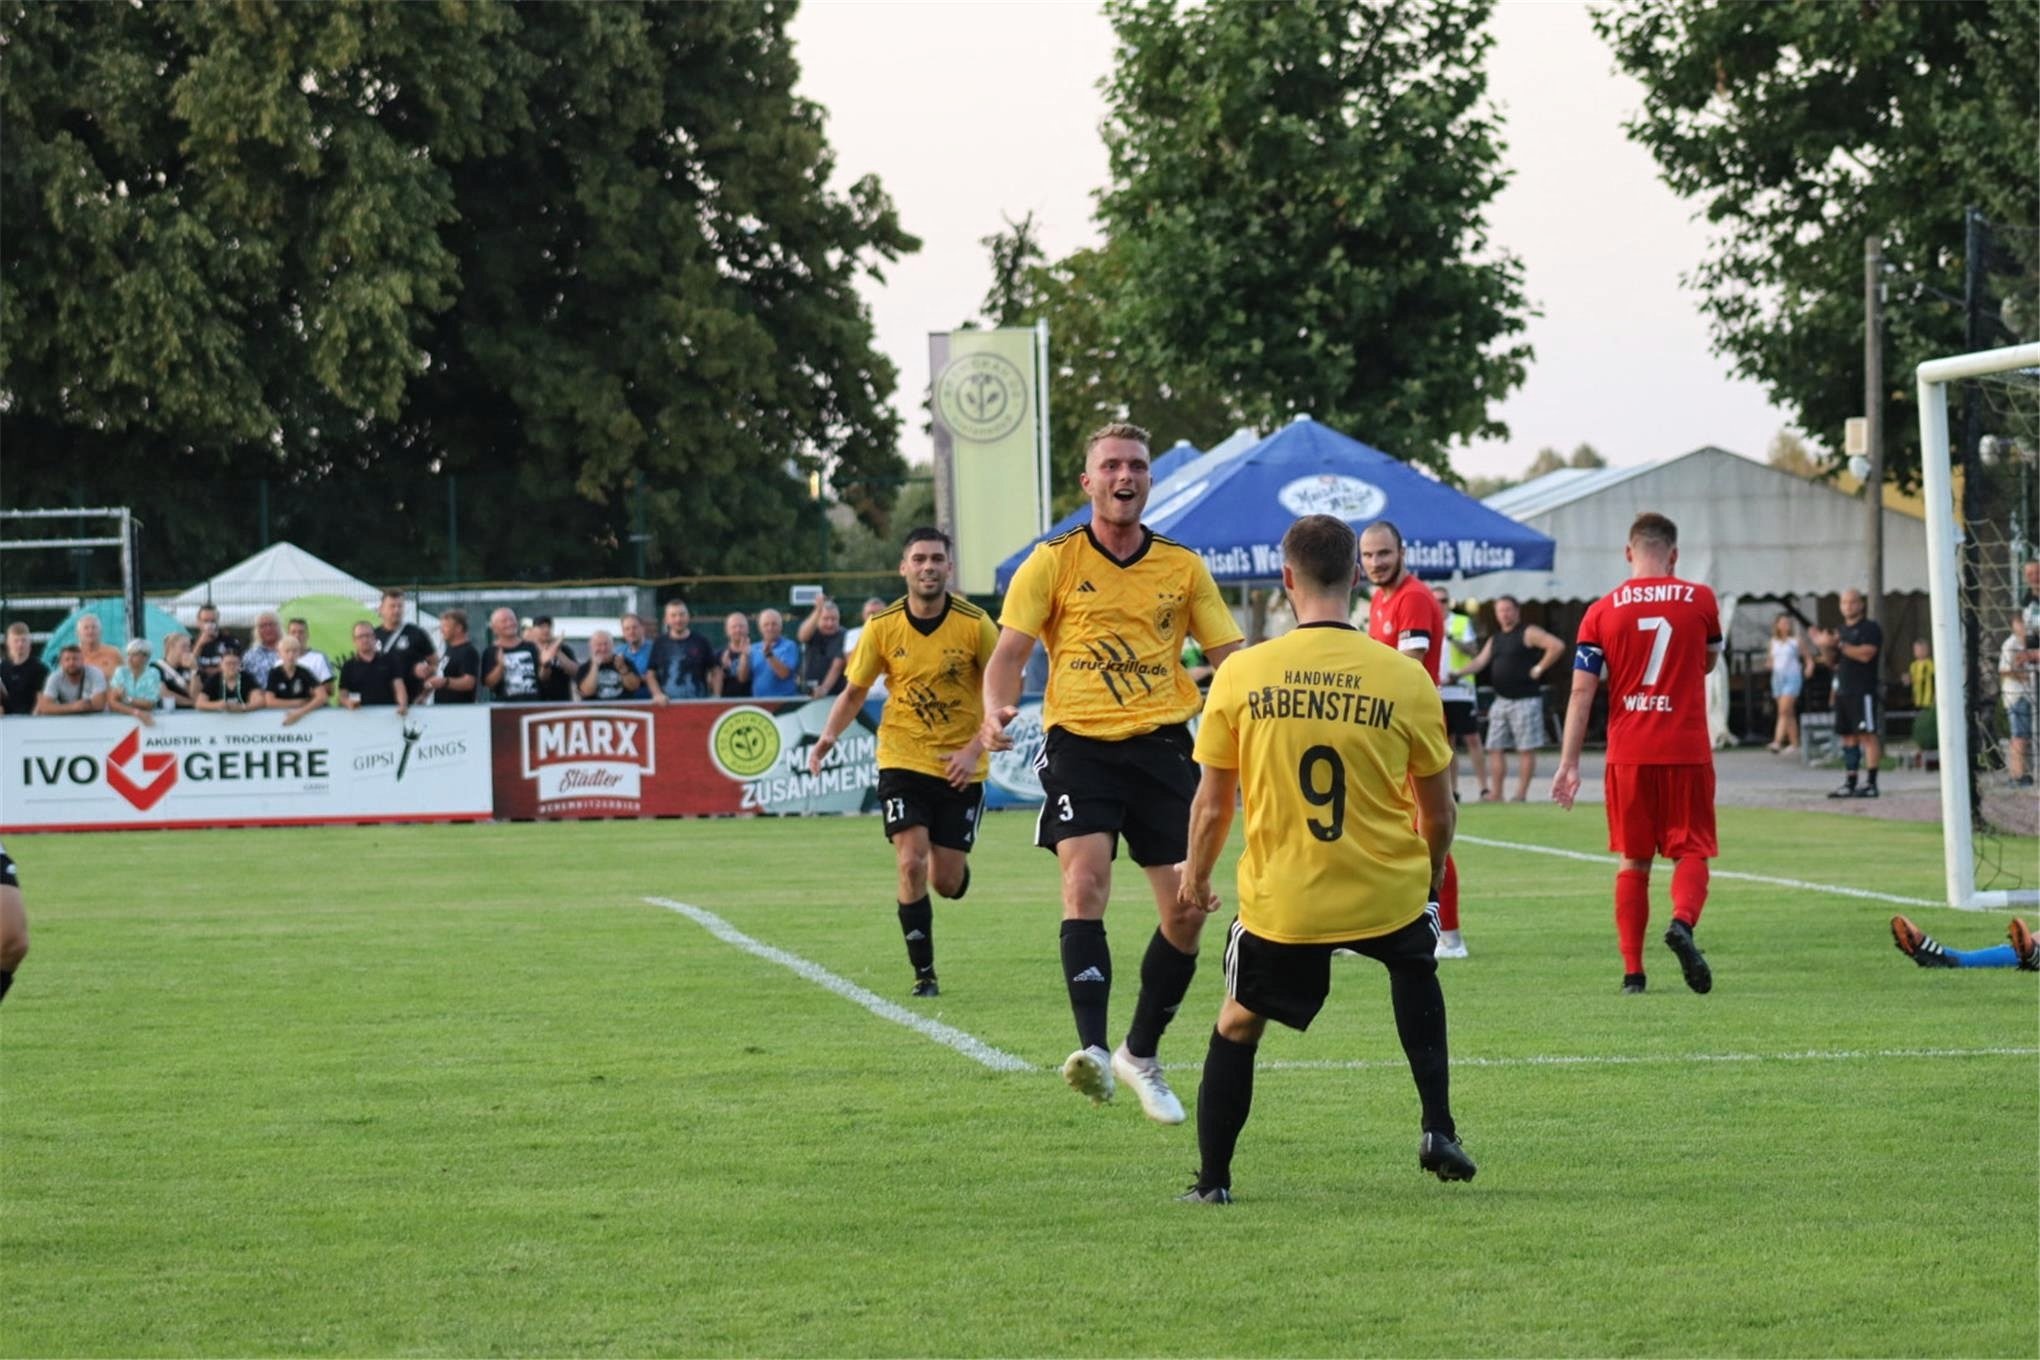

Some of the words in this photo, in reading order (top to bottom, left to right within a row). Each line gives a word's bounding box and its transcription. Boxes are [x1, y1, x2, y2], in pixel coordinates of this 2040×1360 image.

[1457, 540, 1515, 568] Weisse
[1612, 585, 1695, 608] LÖSSNITZ
[1637, 616, 1673, 686] 7
[1070, 658, 1168, 676] druckzilla.de
[1284, 670, 1362, 689] HANDWERK
[1248, 688, 1394, 730] RABENSTEIN
[1623, 692, 1673, 712] WÖLFEL
[146, 736, 202, 747] AKUSTIK
[209, 736, 218, 745] &
[225, 734, 313, 745] TROCKENBAU
[537, 720, 641, 760] MARX
[23, 755, 99, 785] IVO
[184, 749, 330, 781] GEHRE
[353, 751, 395, 771] GIPSI
[418, 740, 467, 760] KINGS
[1299, 744, 1346, 842] 9
[886, 797, 905, 823] 27
[1057, 794, 1074, 821] 3
